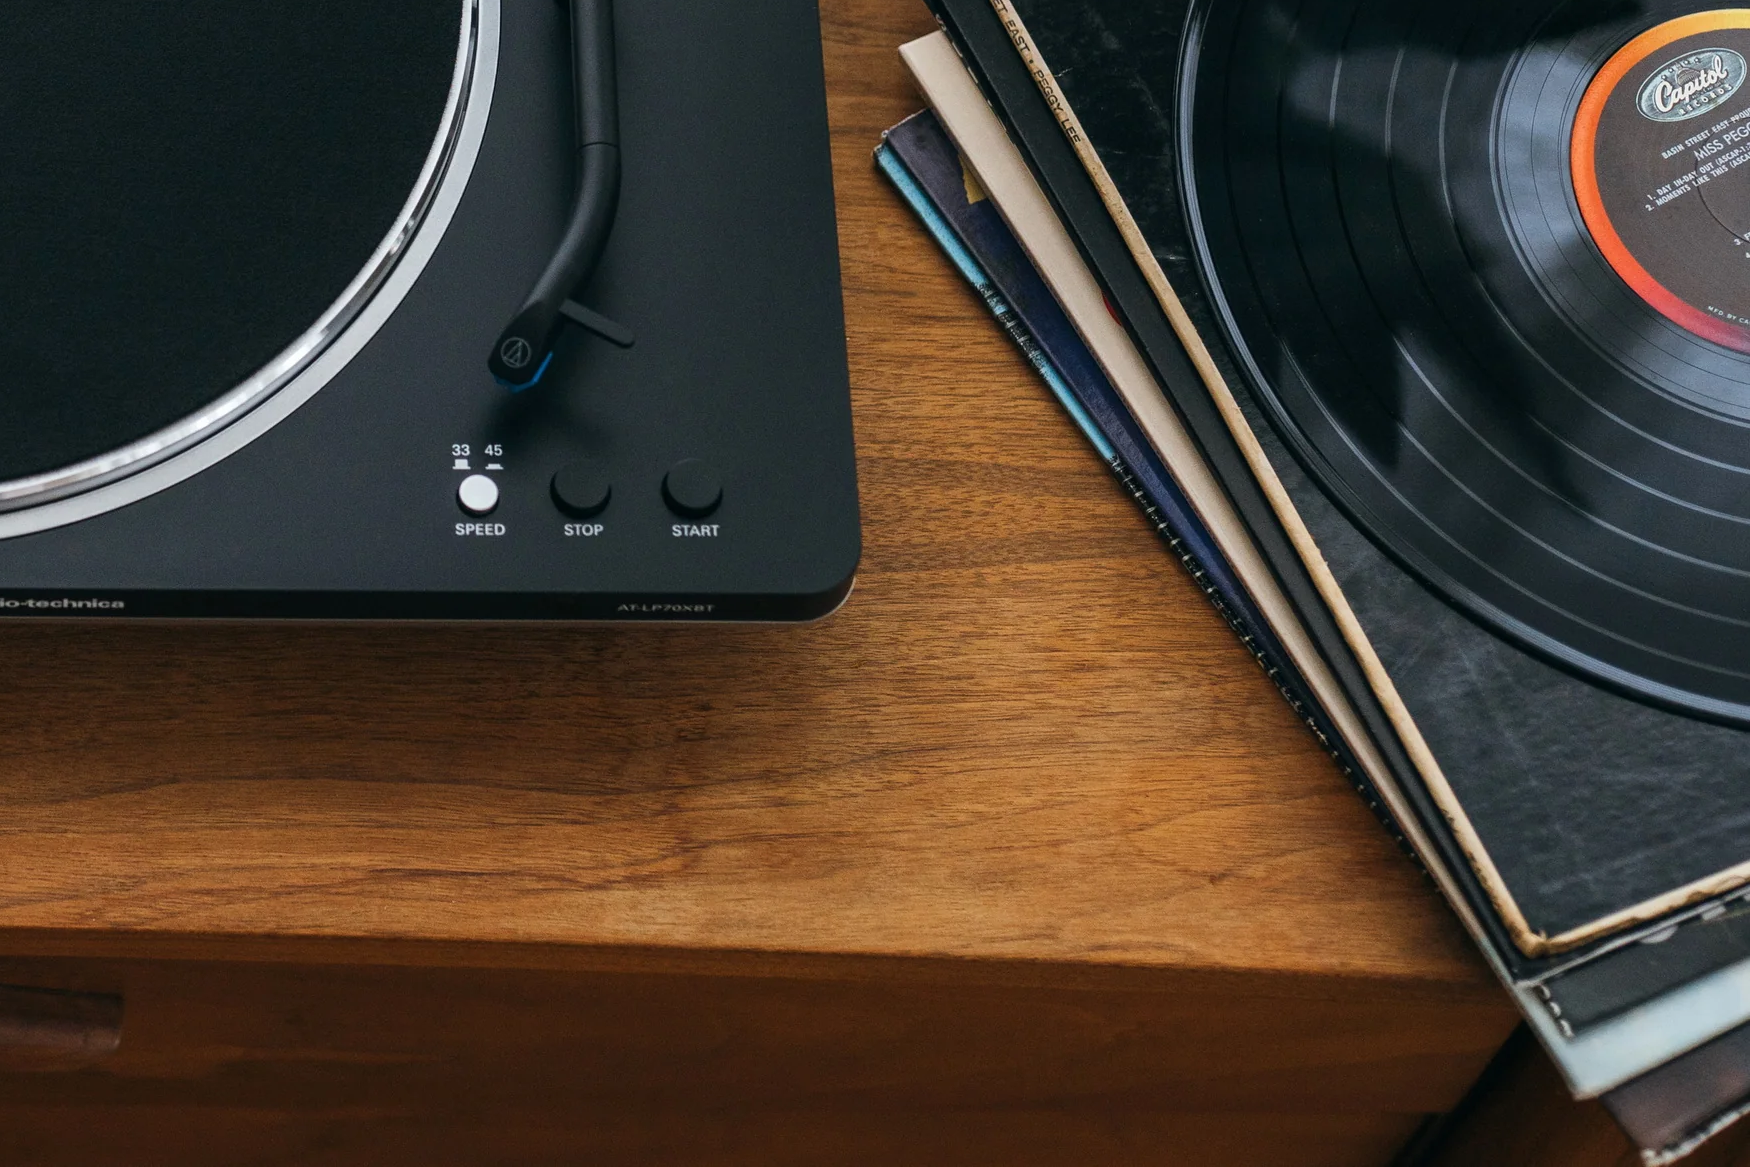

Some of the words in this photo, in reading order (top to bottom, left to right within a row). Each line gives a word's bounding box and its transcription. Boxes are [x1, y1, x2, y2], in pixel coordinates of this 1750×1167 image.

[1005, 20, 1031, 53] EAST
[1033, 69, 1064, 112] PEGGY
[1060, 117, 1082, 146] LEE
[1654, 54, 1729, 113] Capitol
[1661, 143, 1685, 159] BASIN
[1684, 130, 1711, 147] STREET
[1711, 120, 1730, 133] EAST
[1693, 139, 1724, 161] MISS
[1655, 184, 1691, 206] MOMENTS
[1691, 174, 1710, 187] LIKE
[1710, 165, 1729, 177] THIS
[1656, 183, 1672, 196] DAY
[1673, 170, 1698, 187] IN-DAY
[1699, 162, 1715, 174] OUT
[451, 444, 471, 456] 33
[484, 444, 503, 456] 45
[455, 523, 506, 536] SPEED
[564, 524, 604, 536] STOP
[671, 524, 720, 537] START
